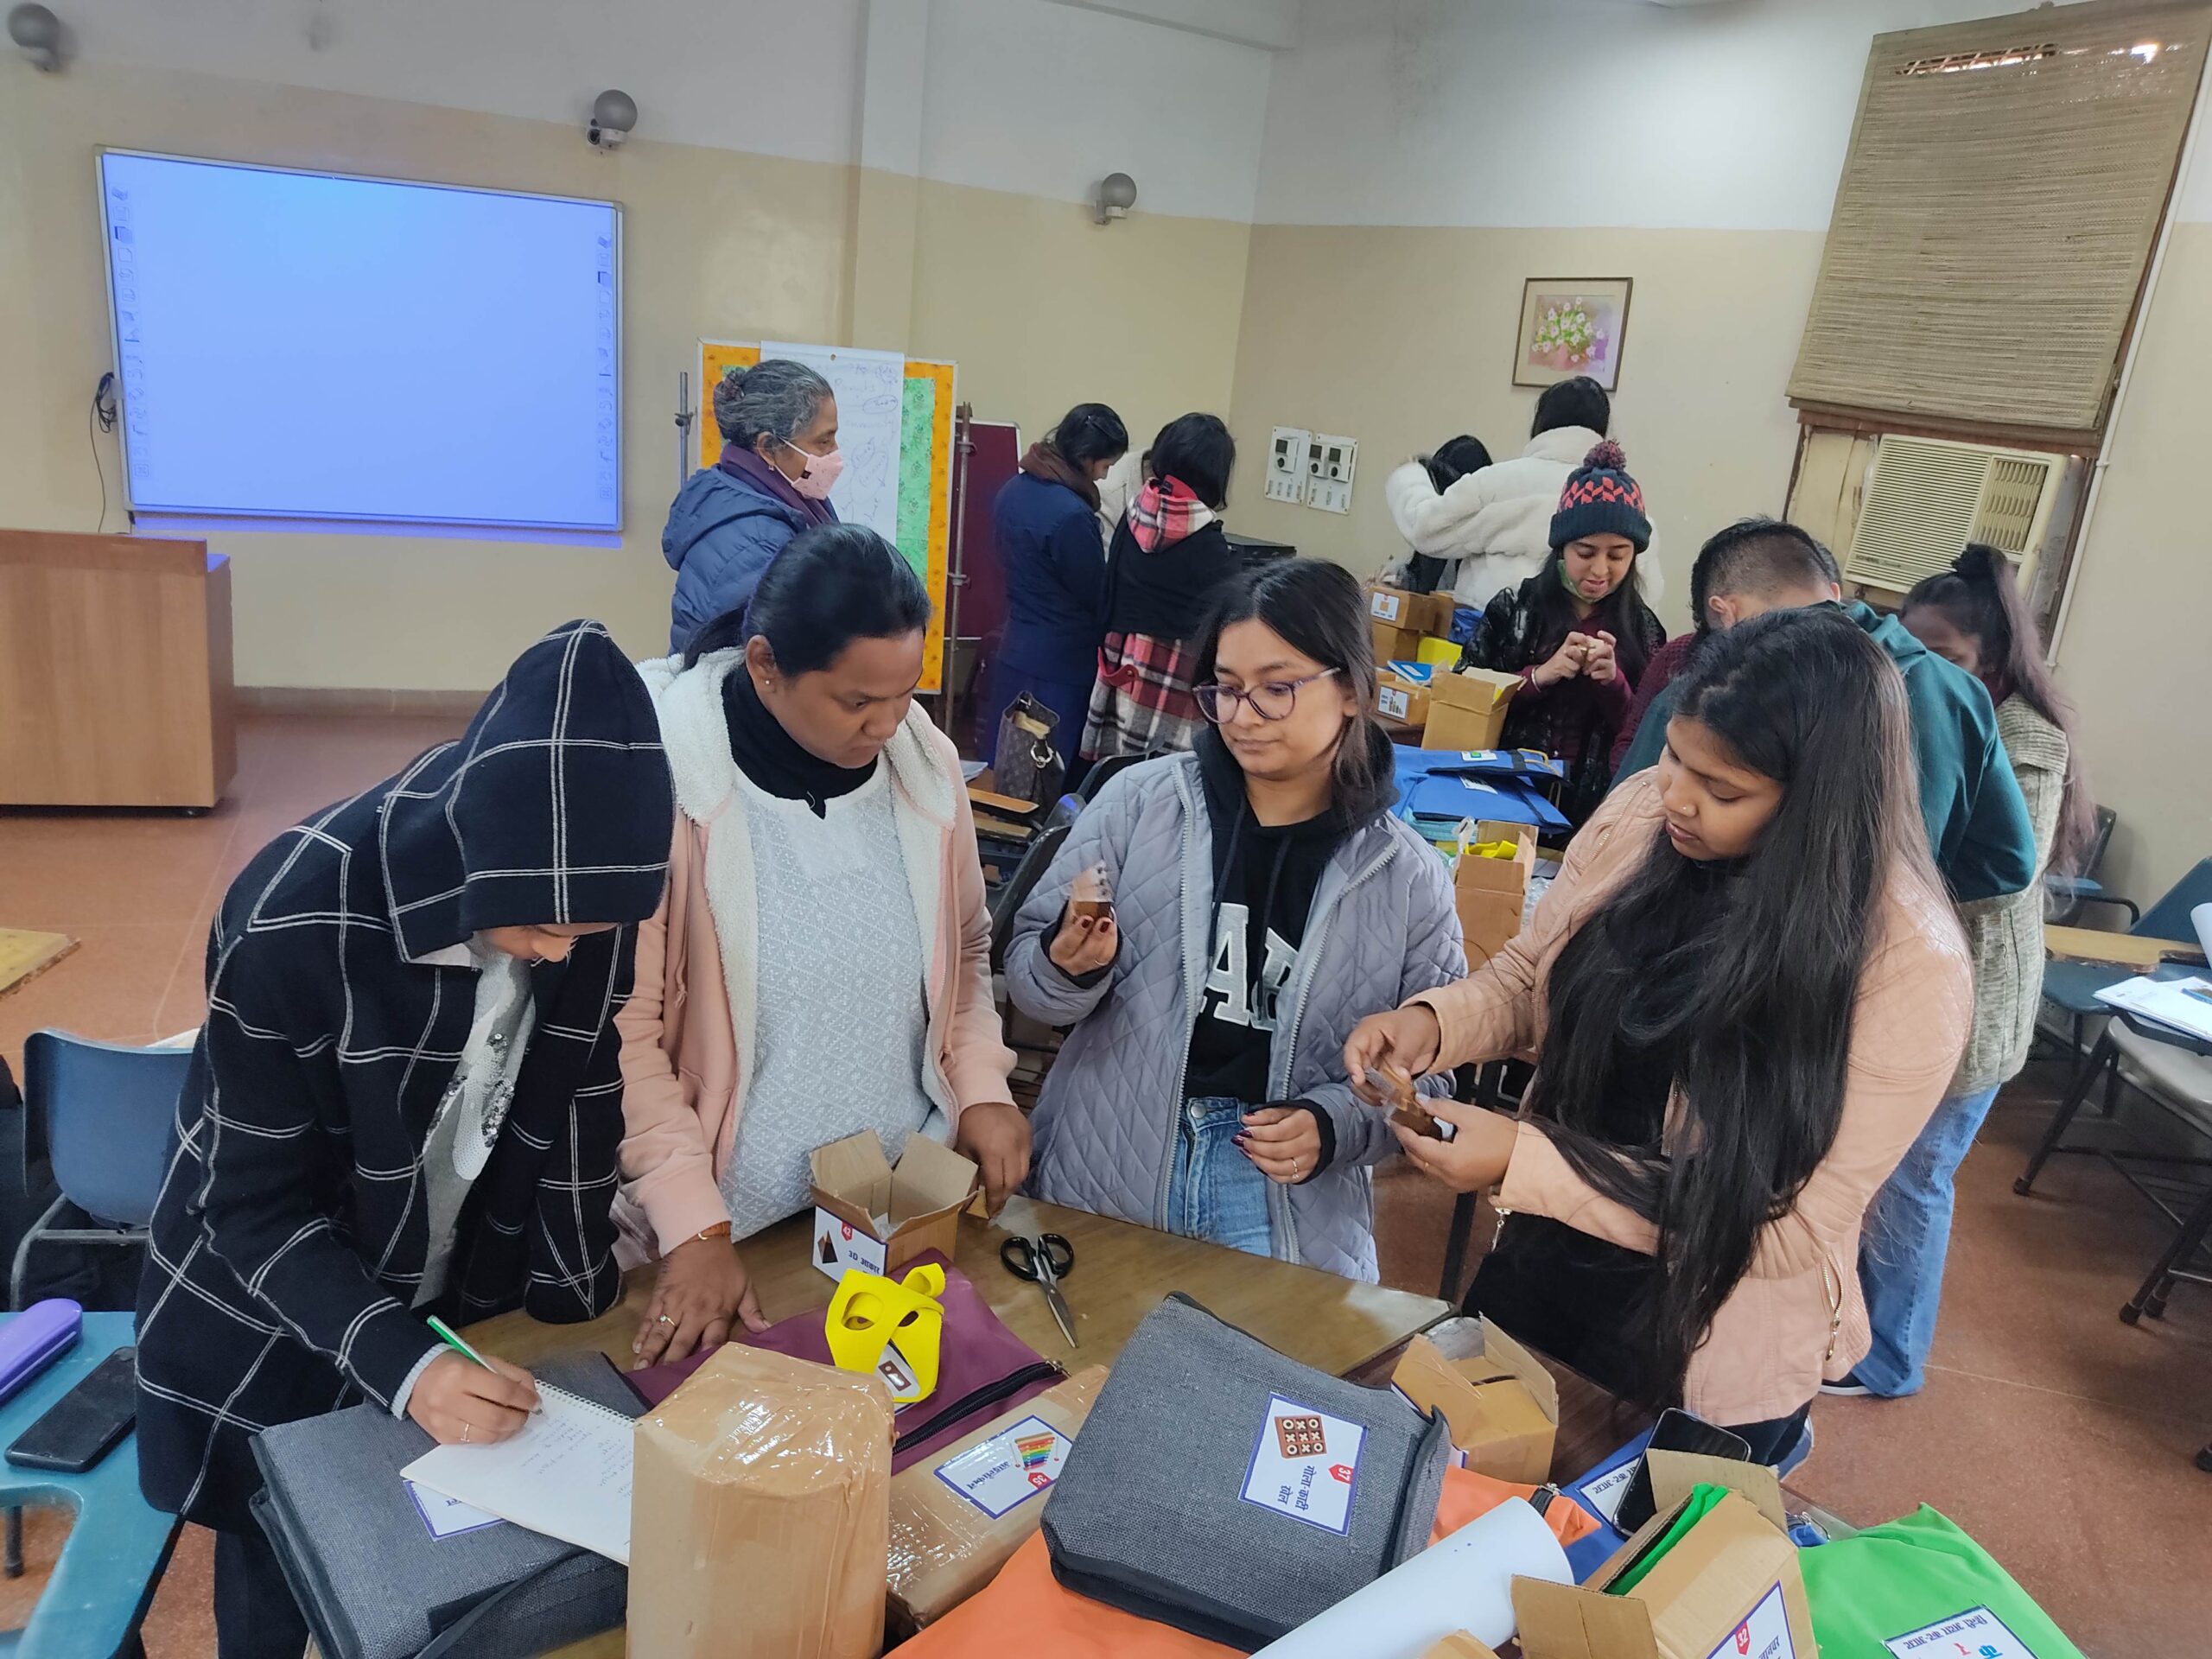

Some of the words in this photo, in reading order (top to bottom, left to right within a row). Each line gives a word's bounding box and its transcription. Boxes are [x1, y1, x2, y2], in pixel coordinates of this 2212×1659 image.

[1033, 1474, 1047, 1485] 35
[1338, 1467, 1351, 1482] 37
[1277, 1484, 1294, 1504] खेल
[1737, 1628, 1749, 1648] 32
